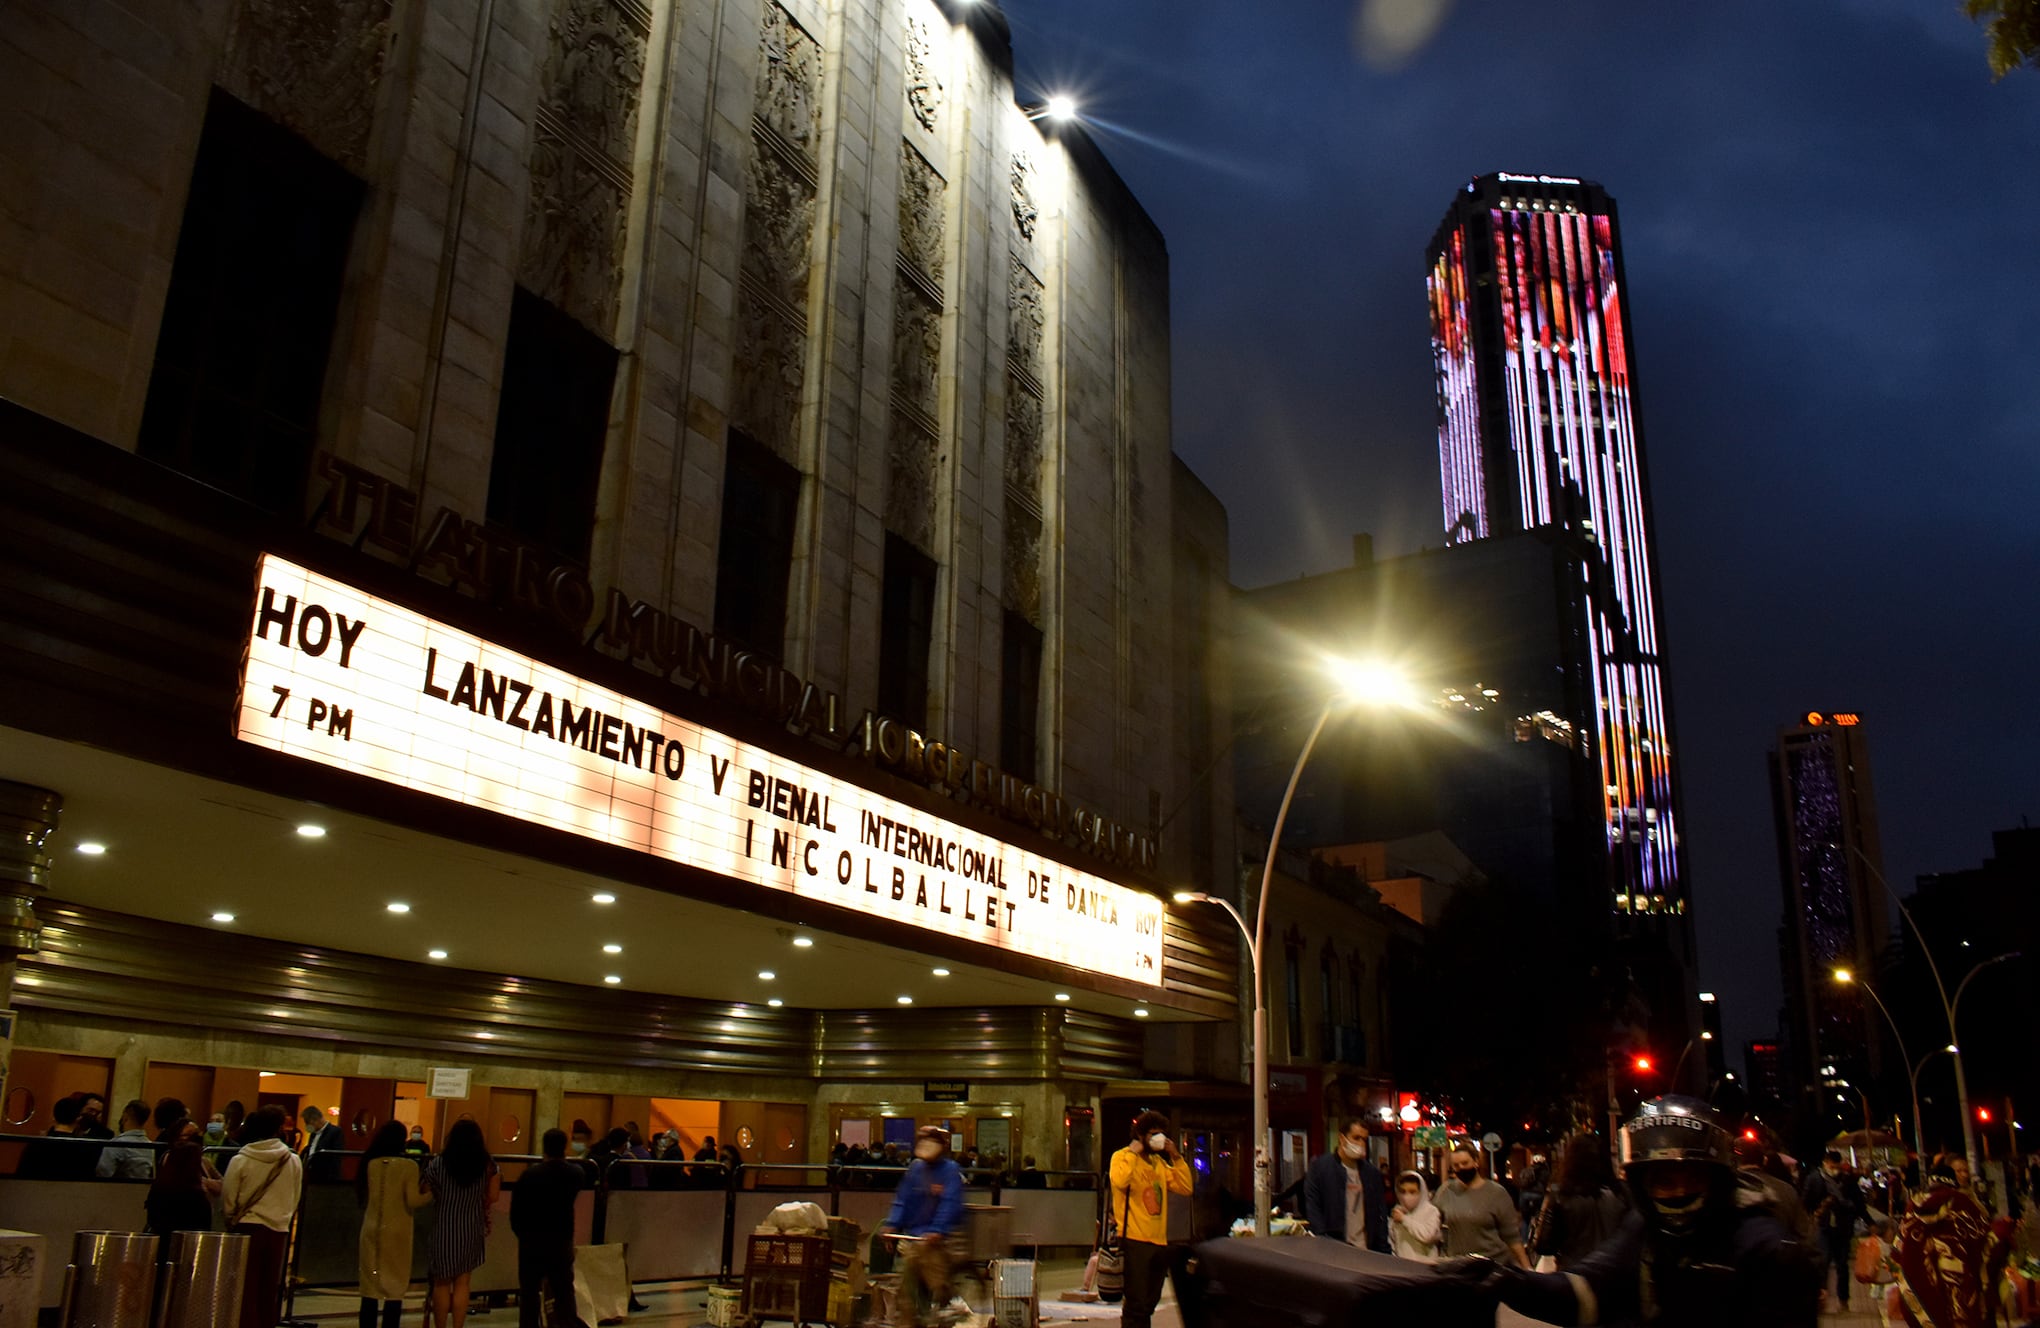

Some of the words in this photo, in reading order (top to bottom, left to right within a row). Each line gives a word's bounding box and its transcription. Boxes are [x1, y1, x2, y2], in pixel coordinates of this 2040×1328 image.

[270, 685, 290, 719] 7
[307, 697, 353, 742] PM
[256, 586, 367, 669] HOY
[423, 647, 685, 781] LANZAMIENTO
[711, 755, 730, 796] V
[747, 769, 836, 834] BIENAL
[860, 809, 1007, 891] INTERNACIONAL
[1028, 870, 1051, 904] DE
[1067, 882, 1118, 926] DANZA
[1135, 910, 1157, 937] HOY
[745, 819, 1016, 932] INCOLBALLET
[1628, 1115, 1704, 1133] CERTIFIED
